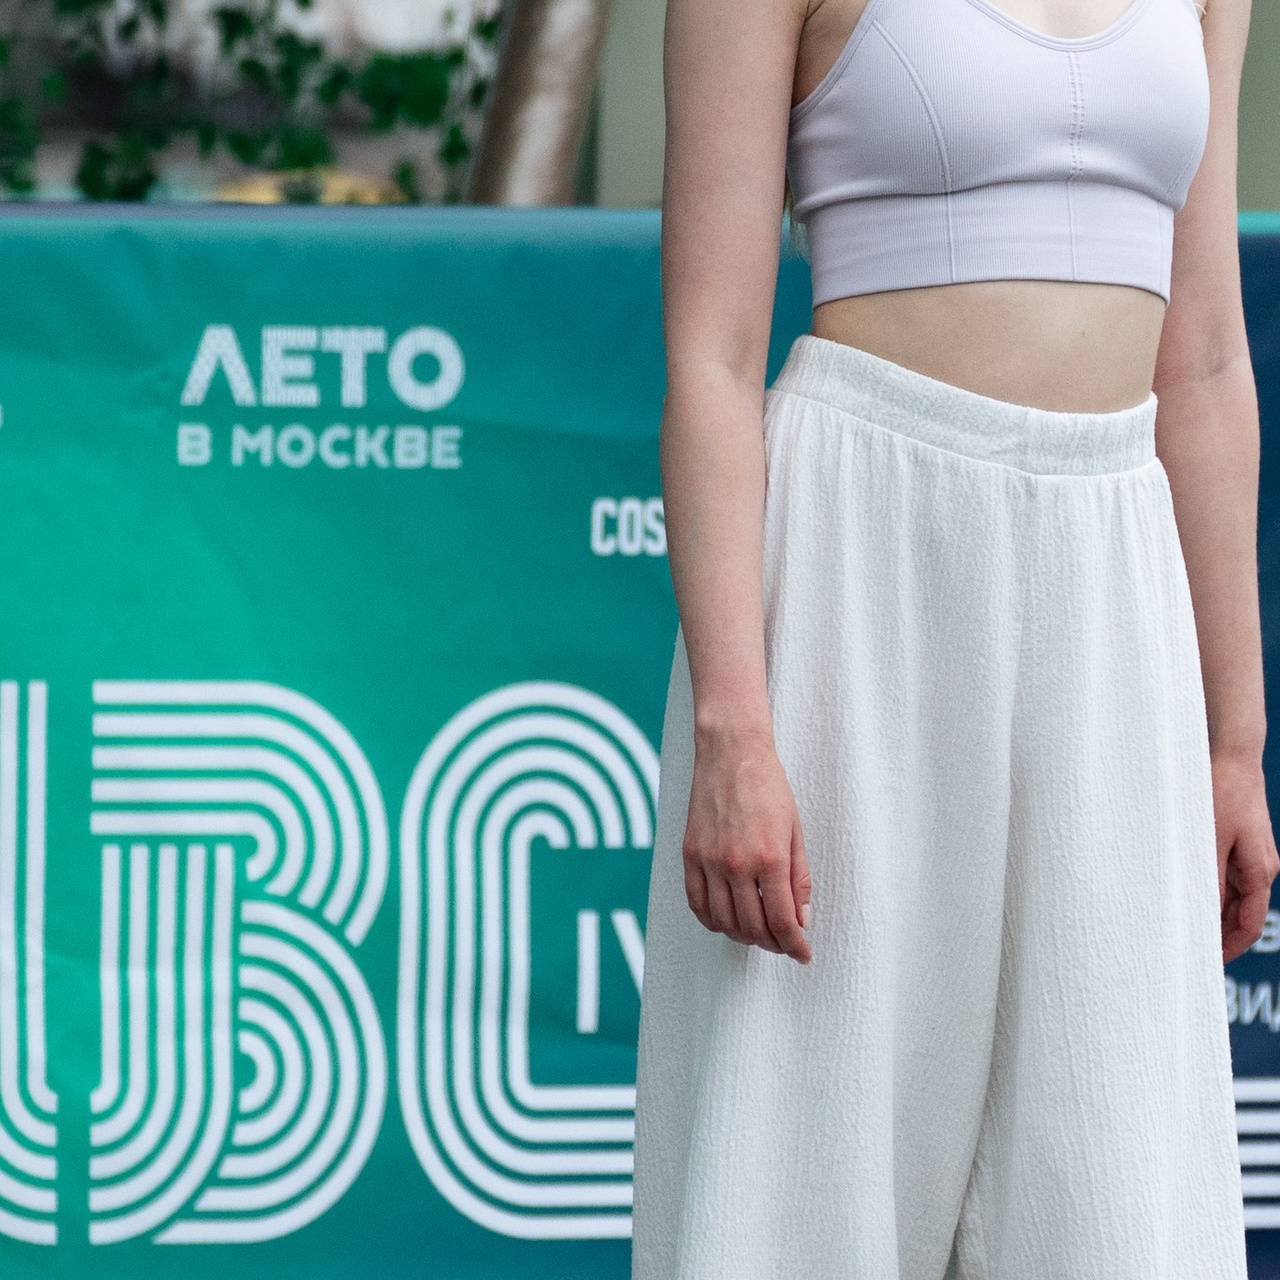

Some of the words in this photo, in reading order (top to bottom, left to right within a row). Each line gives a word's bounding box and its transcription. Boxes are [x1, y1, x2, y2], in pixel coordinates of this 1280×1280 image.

[181, 324, 466, 411] ЛЕТО
[177, 423, 211, 466] В
[231, 424, 463, 469] МОСКВЕ
